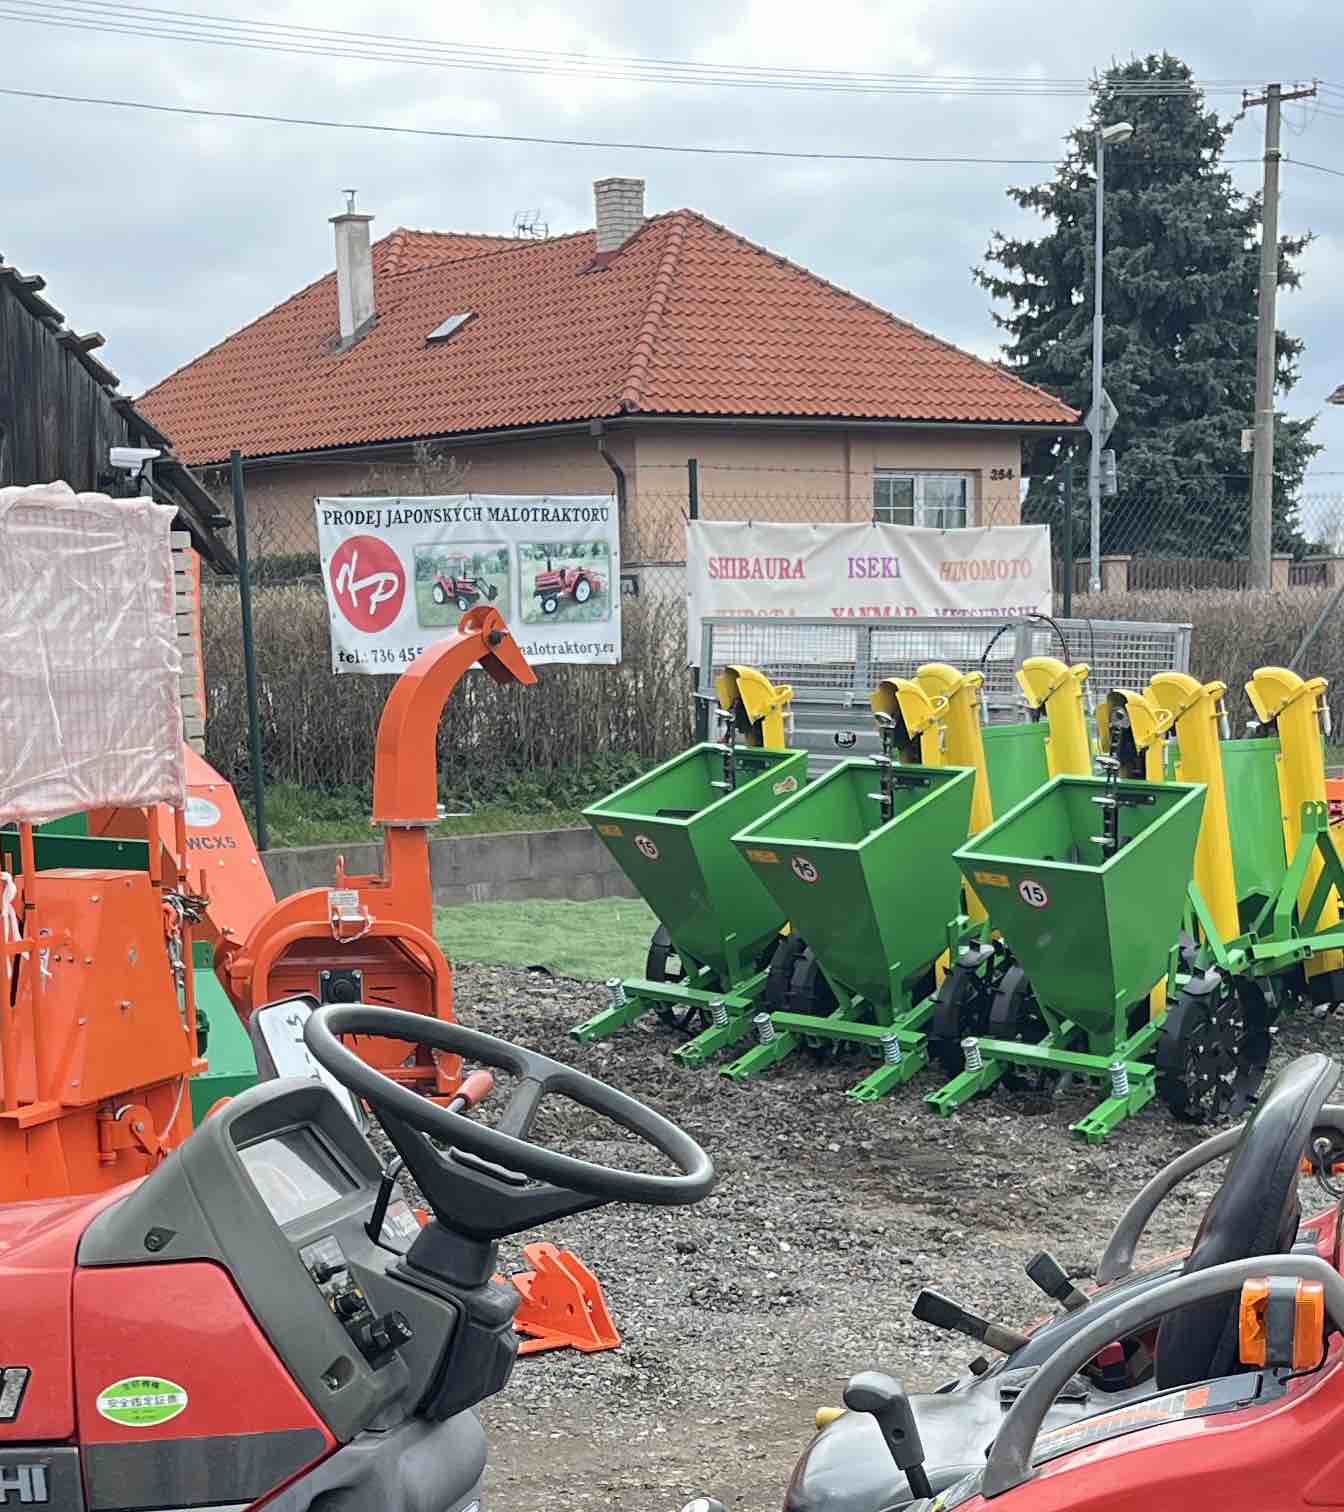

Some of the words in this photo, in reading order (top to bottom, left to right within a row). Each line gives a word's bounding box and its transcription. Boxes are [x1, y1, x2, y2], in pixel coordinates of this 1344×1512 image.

[323, 509, 383, 528] PRODEJ
[708, 556, 806, 580] SHIBAURA
[847, 556, 902, 579] ISEKI
[939, 558, 1033, 582] HINOMOTO
[371, 647, 395, 663] 736
[639, 839, 656, 855] 15
[795, 861, 815, 878] 15
[1023, 885, 1044, 902] 15
